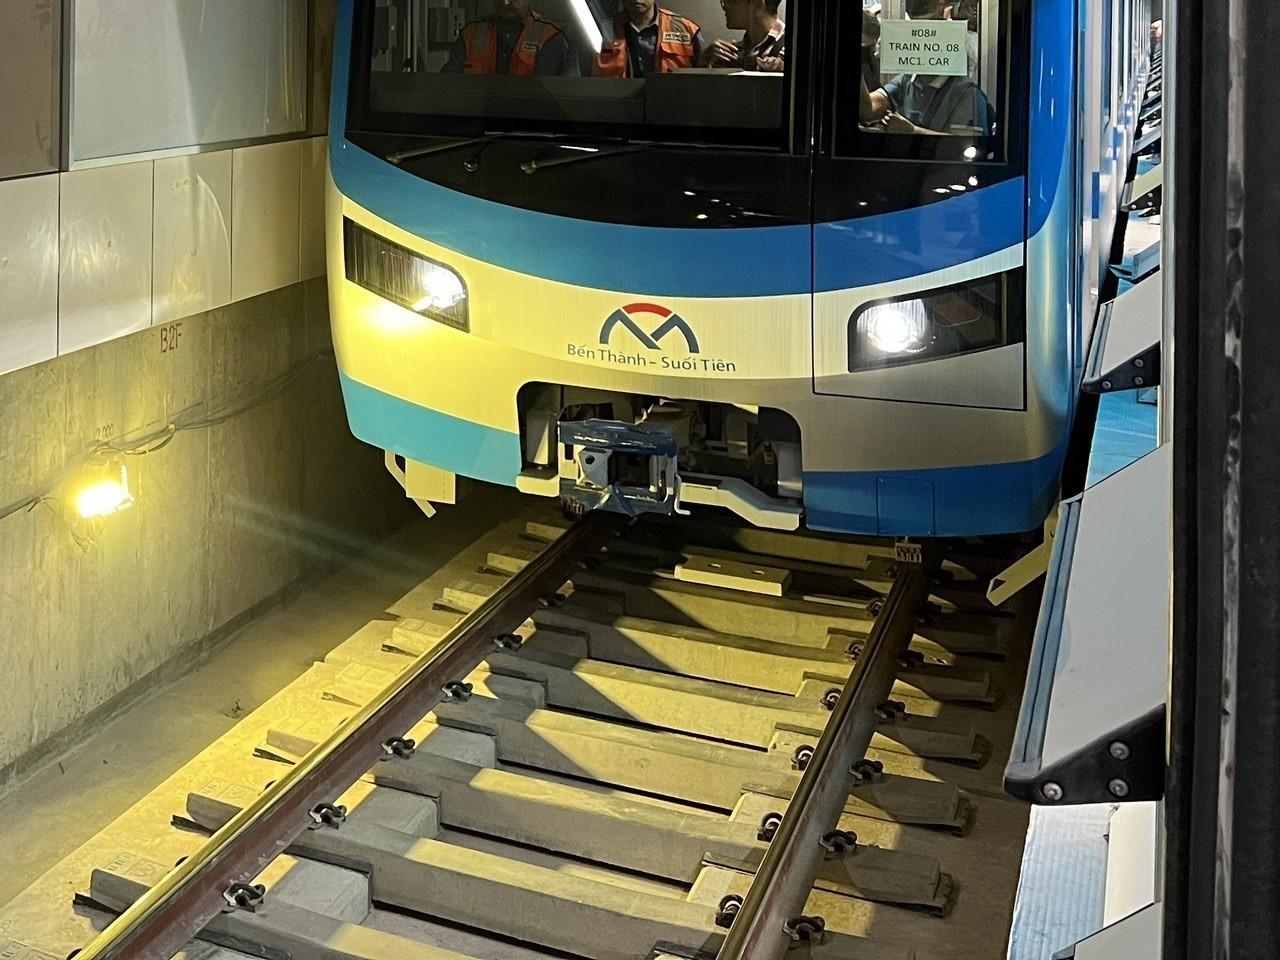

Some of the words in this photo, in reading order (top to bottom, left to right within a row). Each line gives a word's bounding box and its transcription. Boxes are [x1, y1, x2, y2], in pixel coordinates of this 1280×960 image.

[889, 42, 921, 52] TRAIN
[923, 43, 944, 53] NO.
[946, 43, 960, 53] 08
[898, 56, 926, 66] MC1.
[928, 57, 950, 66] CAR
[567, 343, 596, 359] Bến
[598, 349, 647, 367] Thành
[661, 356, 697, 371] Suối
[701, 358, 737, 373] Tiên
